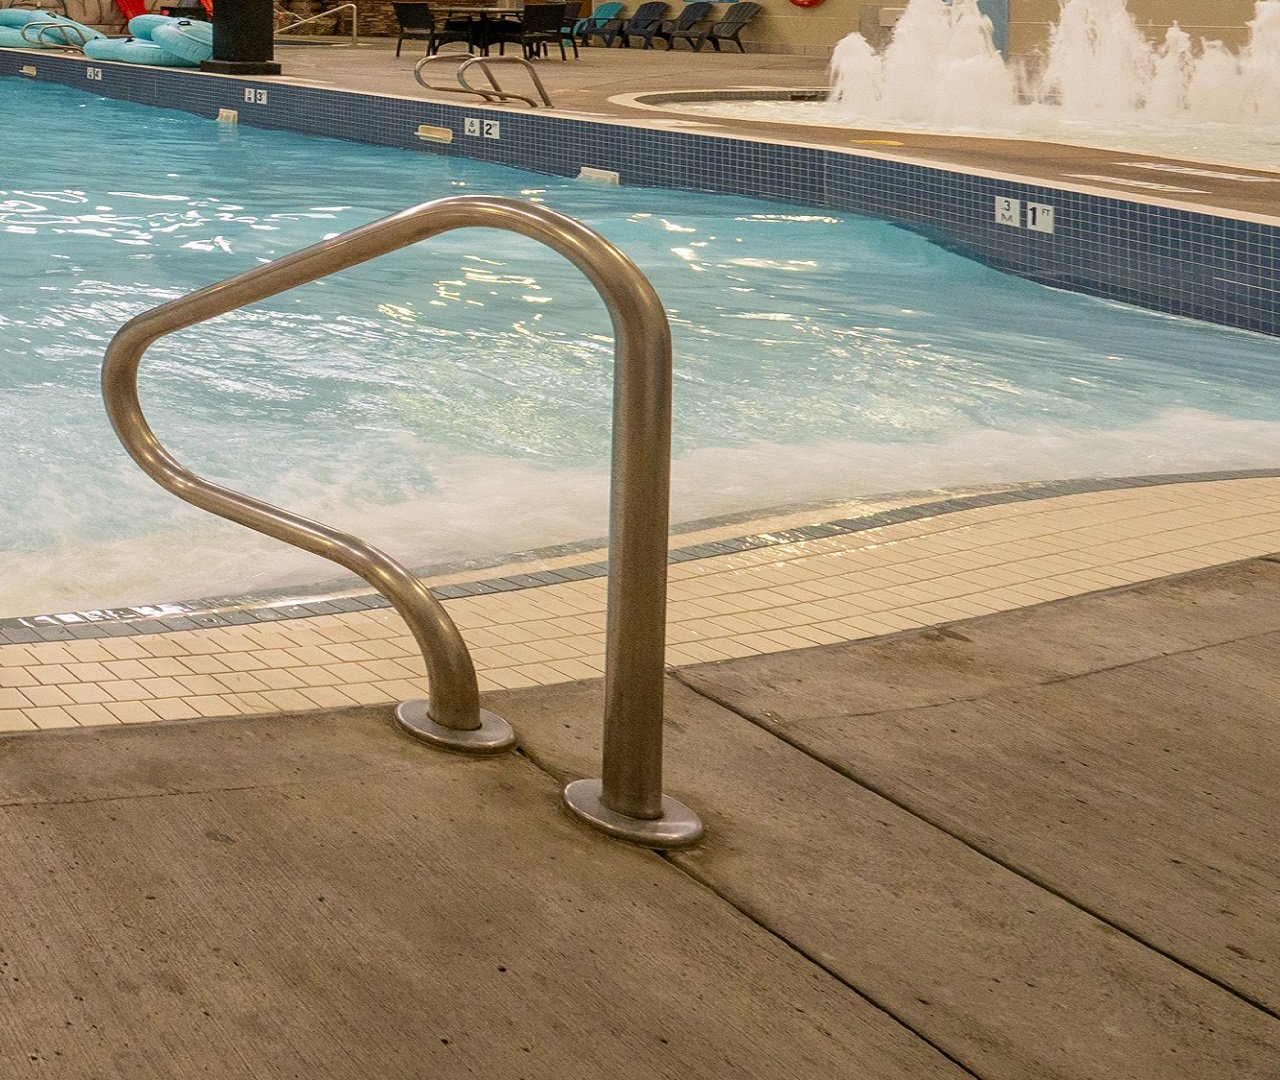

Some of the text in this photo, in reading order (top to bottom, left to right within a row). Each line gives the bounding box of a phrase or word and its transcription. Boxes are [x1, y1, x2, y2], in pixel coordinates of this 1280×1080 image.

[485, 123, 492, 135] 2
[1001, 213, 1013, 222] M
[1030, 206, 1051, 226] 1 FT
